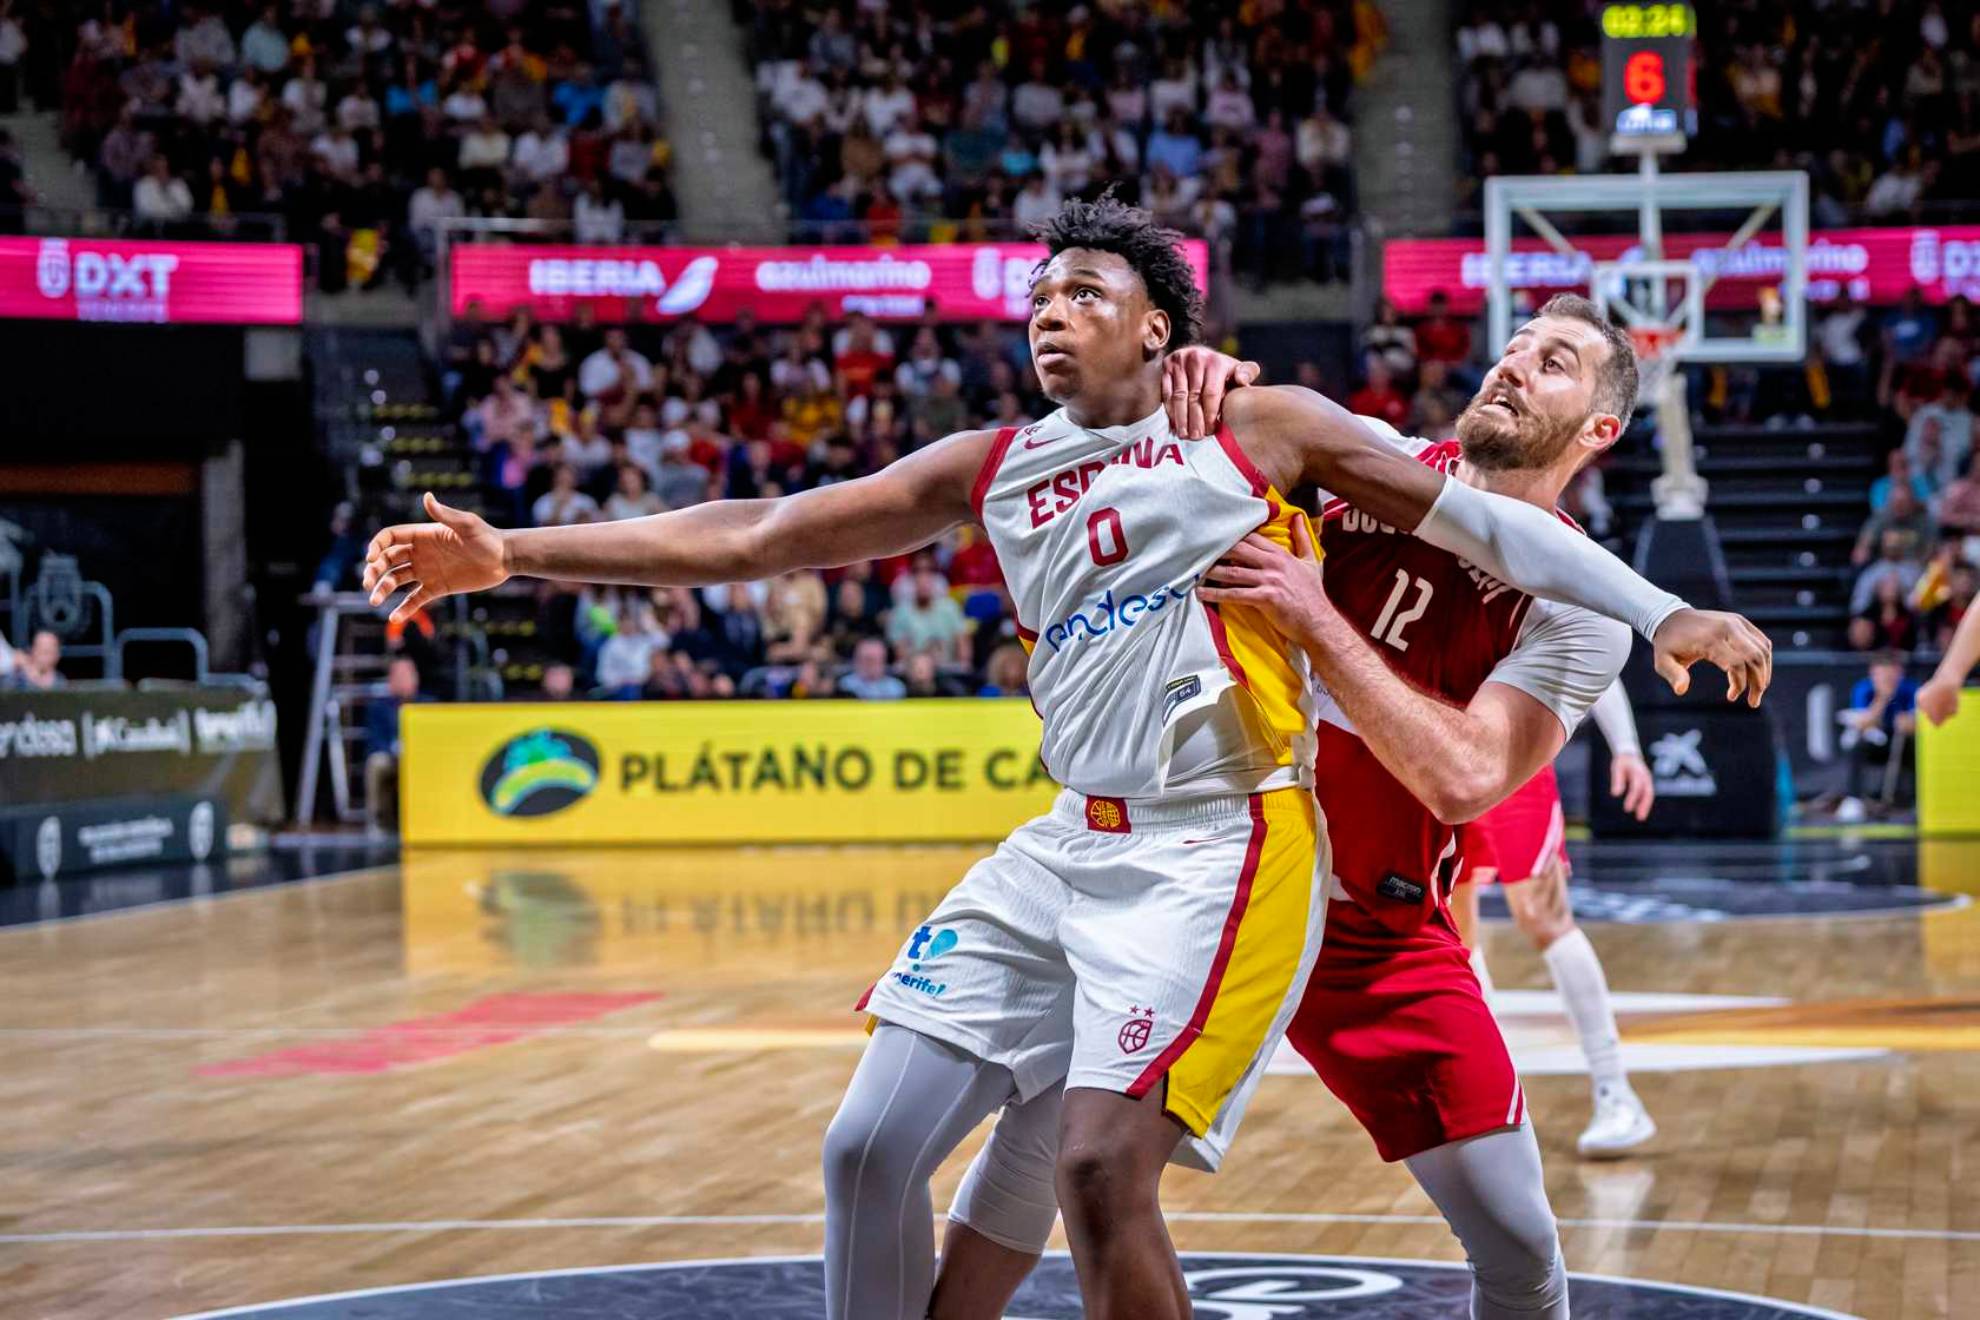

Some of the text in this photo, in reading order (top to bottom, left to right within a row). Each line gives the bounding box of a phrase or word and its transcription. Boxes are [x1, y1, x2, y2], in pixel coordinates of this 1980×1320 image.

[1624, 51, 1665, 105] 6
[74, 252, 179, 298] DXT
[529, 258, 666, 296] IBERIA
[1087, 507, 1129, 567] 0
[1370, 568, 1434, 652] 12
[620, 741, 872, 793] PLÁTANO
[893, 748, 965, 792] DE
